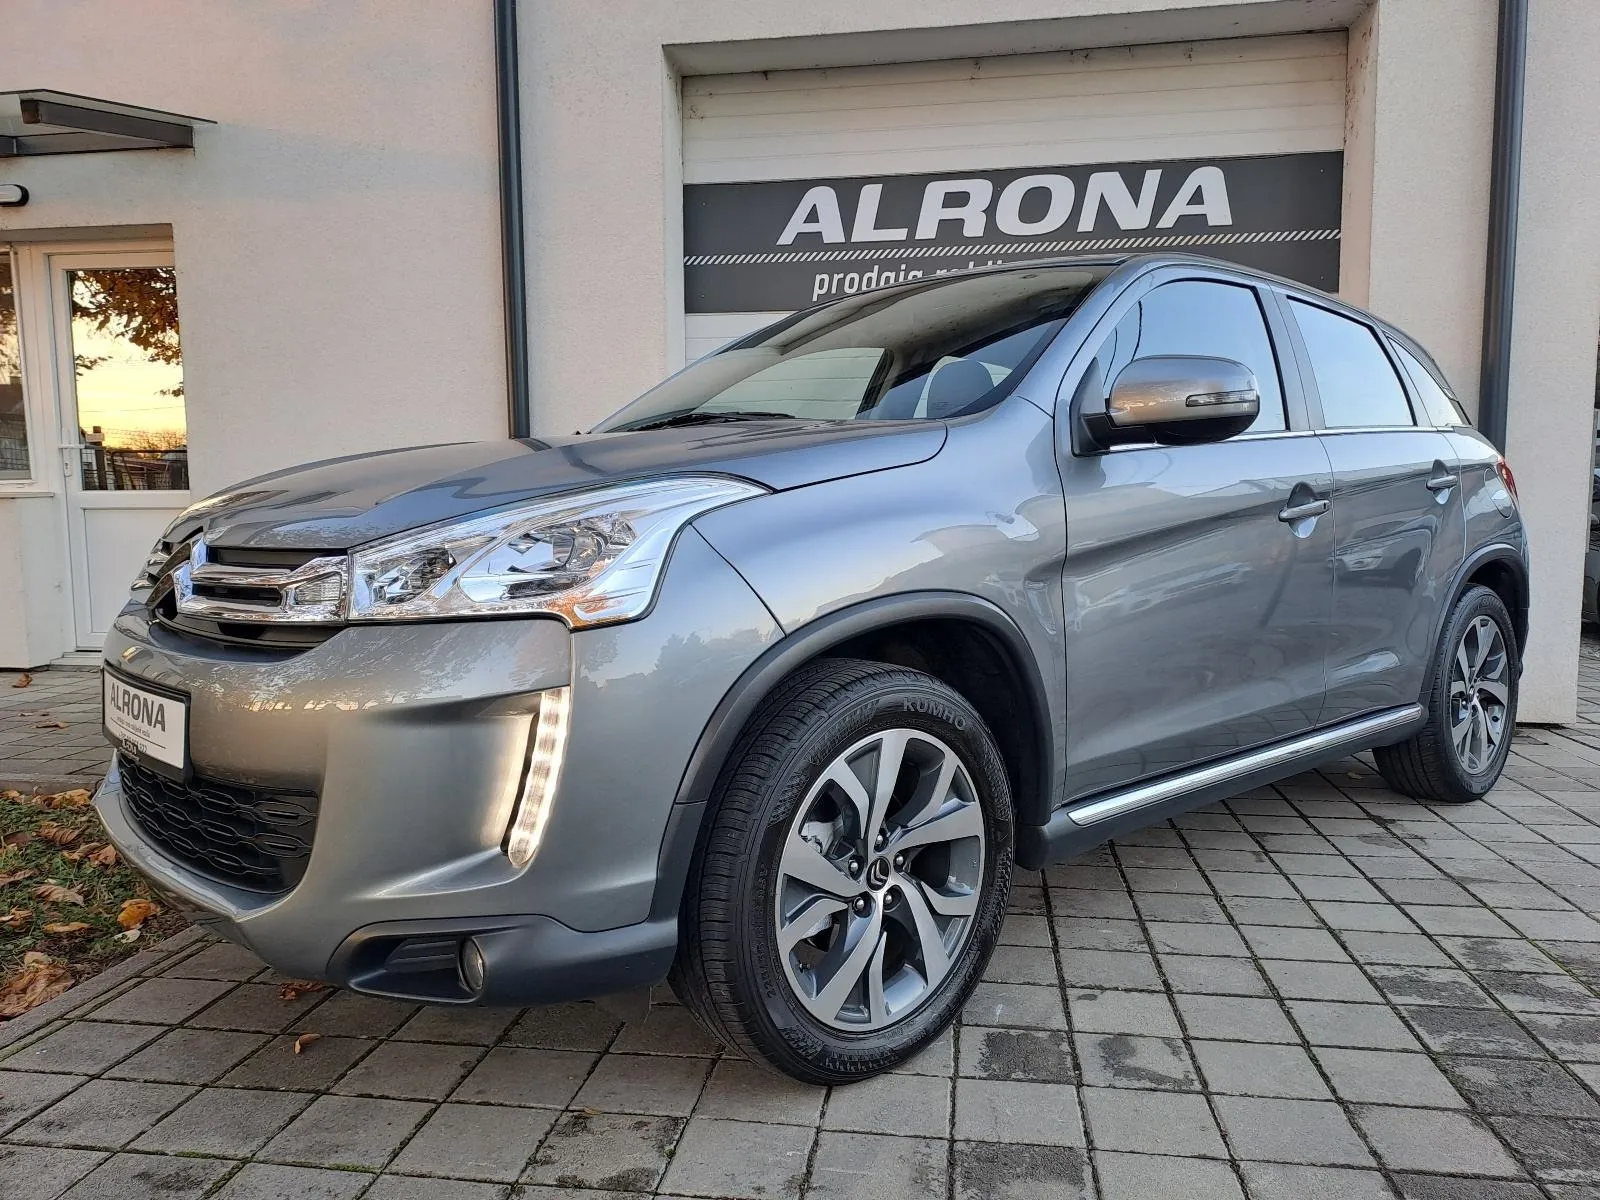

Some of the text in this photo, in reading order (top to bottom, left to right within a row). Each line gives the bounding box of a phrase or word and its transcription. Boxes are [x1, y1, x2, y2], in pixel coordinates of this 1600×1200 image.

[776, 166, 1233, 247] ALRONA
[110, 681, 166, 733] ALRONA
[903, 697, 967, 731] KUMHO
